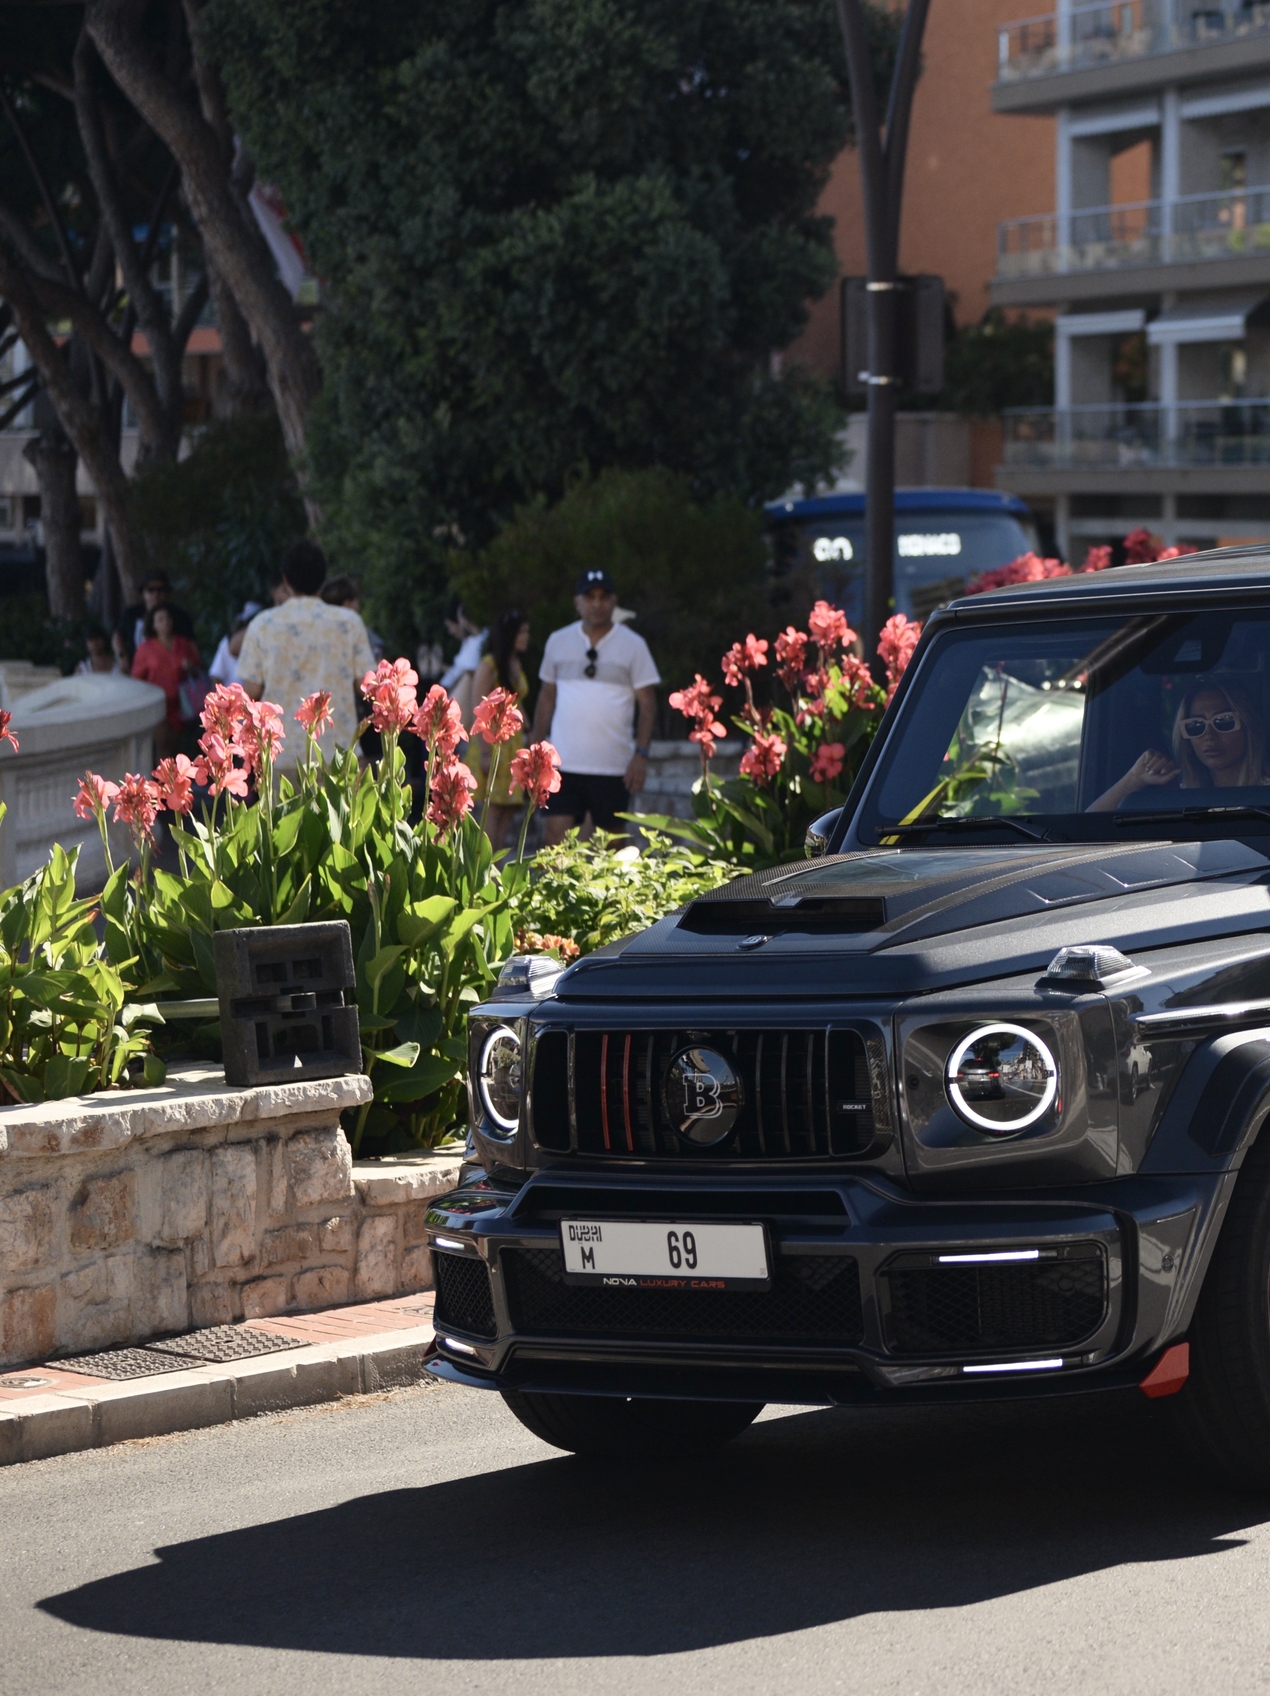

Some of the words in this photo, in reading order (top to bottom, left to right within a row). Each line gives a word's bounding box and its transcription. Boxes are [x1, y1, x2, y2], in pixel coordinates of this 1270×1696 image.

[683, 1073, 723, 1118] B
[568, 1225, 602, 1243] DUBAI
[580, 1246, 596, 1270] M
[667, 1230, 698, 1270] 69
[603, 1277, 637, 1286] NOVA
[640, 1279, 687, 1288] LUXURY
[691, 1280, 726, 1289] CARS
